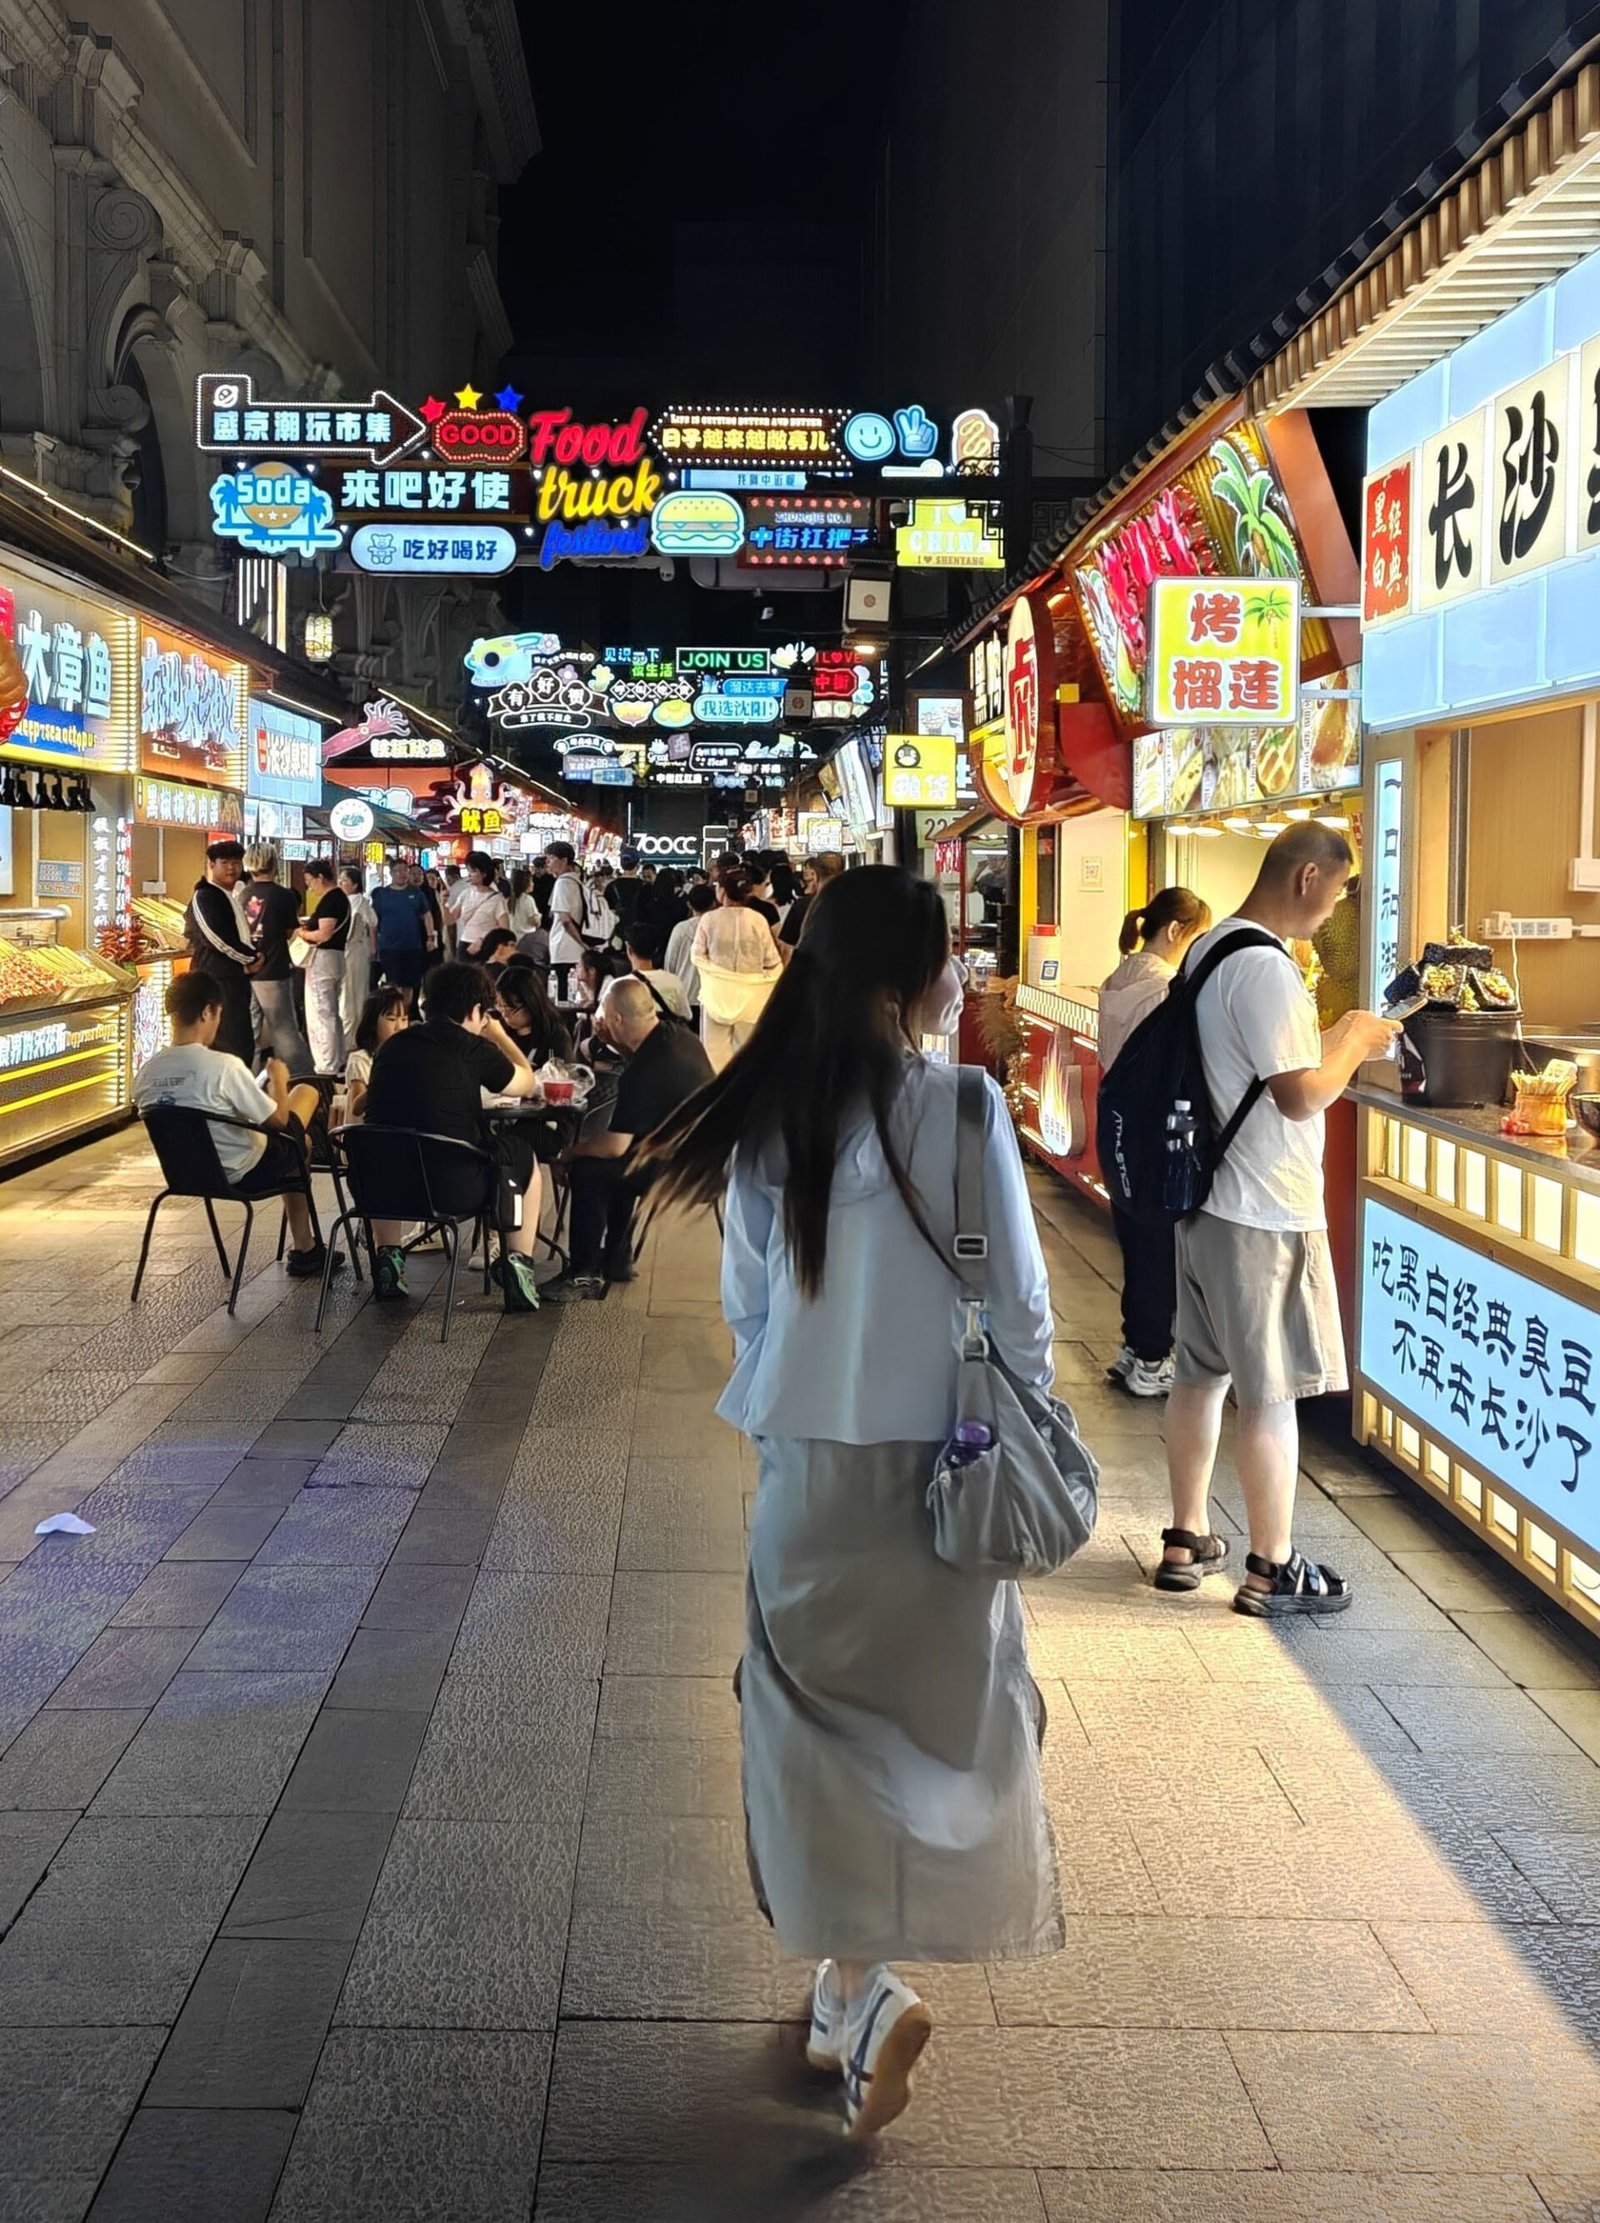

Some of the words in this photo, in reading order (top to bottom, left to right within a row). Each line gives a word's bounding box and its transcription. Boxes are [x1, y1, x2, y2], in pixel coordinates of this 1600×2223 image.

[212, 410, 392, 443] 盛京潮玩市集
[440, 424, 517, 446] GOOD
[529, 406, 648, 466] Food
[662, 427, 830, 451] 日子越来越敞亮儿
[236, 475, 311, 505] Soda
[342, 470, 510, 509] 来吧好使
[538, 459, 661, 521] truck
[1428, 366, 1600, 590] 长沙
[403, 539, 498, 561] 吃好喝好
[541, 519, 649, 571] festival
[935, 556, 985, 566] SHENYANG
[1190, 593, 1241, 643] 烤
[681, 653, 731, 668] JOIN
[737, 653, 765, 668] US
[815, 674, 849, 690] 中街
[1173, 660, 1279, 711] 榴莲
[461, 808, 501, 834] 鱿鱼
[632, 833, 697, 854] 700CC
[1392, 1318, 1593, 1493] 不再去长沙了
